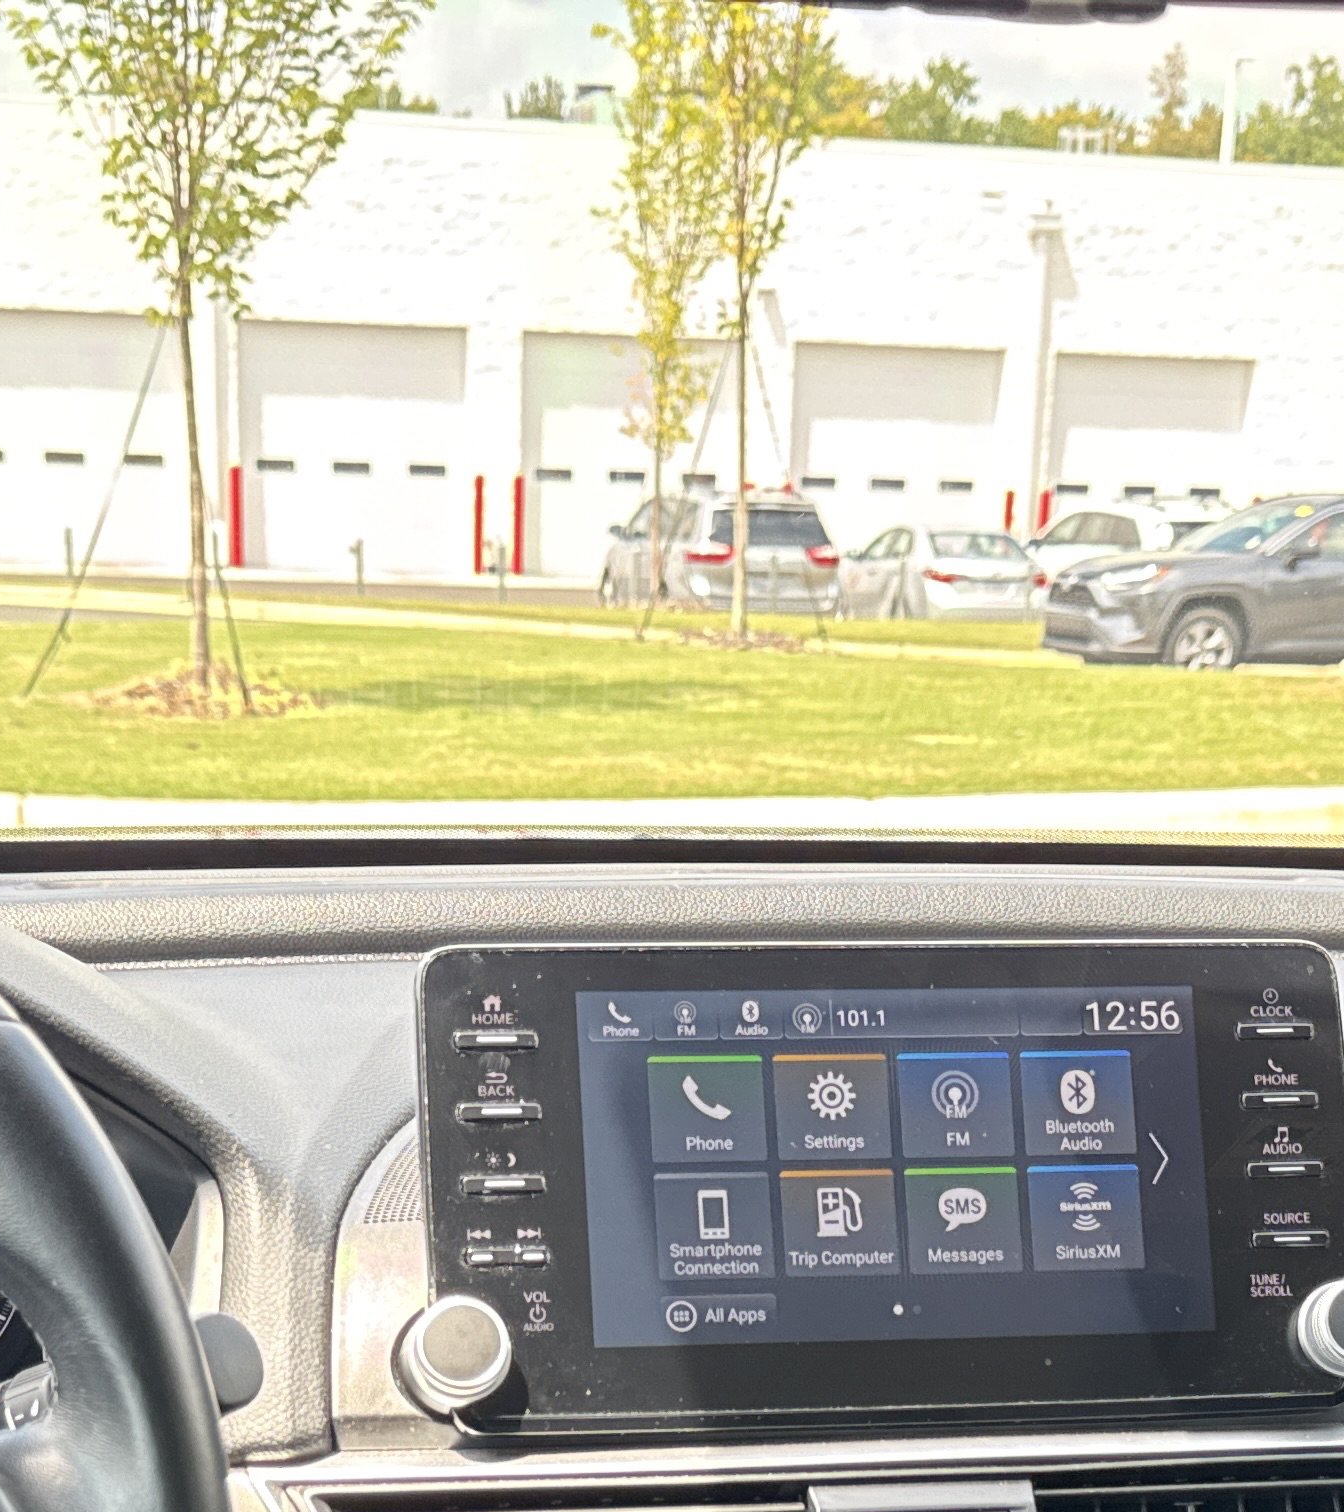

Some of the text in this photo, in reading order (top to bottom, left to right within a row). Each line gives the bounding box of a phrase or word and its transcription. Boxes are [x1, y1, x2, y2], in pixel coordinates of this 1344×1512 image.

[471, 1012, 515, 1026] HOME
[836, 1009, 886, 1027] 101.1
[1085, 1000, 1180, 1032] 12:56
[1250, 1005, 1293, 1018] CLOCK
[602, 1025, 639, 1037] Phone
[677, 1025, 696, 1036] FM
[735, 1024, 768, 1036] Audio
[1254, 1073, 1299, 1087] PHONE
[477, 1083, 516, 1098] BACK
[1045, 1119, 1115, 1134] Bluetooth
[685, 1135, 734, 1151] Phone
[804, 1134, 865, 1151] Settings
[946, 1132, 970, 1147] FM
[1060, 1135, 1103, 1151] Audio
[1262, 1142, 1303, 1155] AUDIO
[943, 1197, 982, 1215] SMS
[1263, 1211, 1310, 1224] SOURCE
[669, 1242, 762, 1260] Smartphone
[927, 1247, 1004, 1264] Messages
[1055, 1243, 1121, 1259] SiriusXM
[789, 1250, 895, 1268] Trip Computer
[674, 1259, 759, 1276] Connection
[1250, 1273, 1286, 1285] TUNE/
[523, 1291, 551, 1304] VOL
[1250, 1285, 1293, 1298] SCROLL
[704, 1307, 767, 1326] All Apps
[523, 1321, 554, 1333] AUDIO
